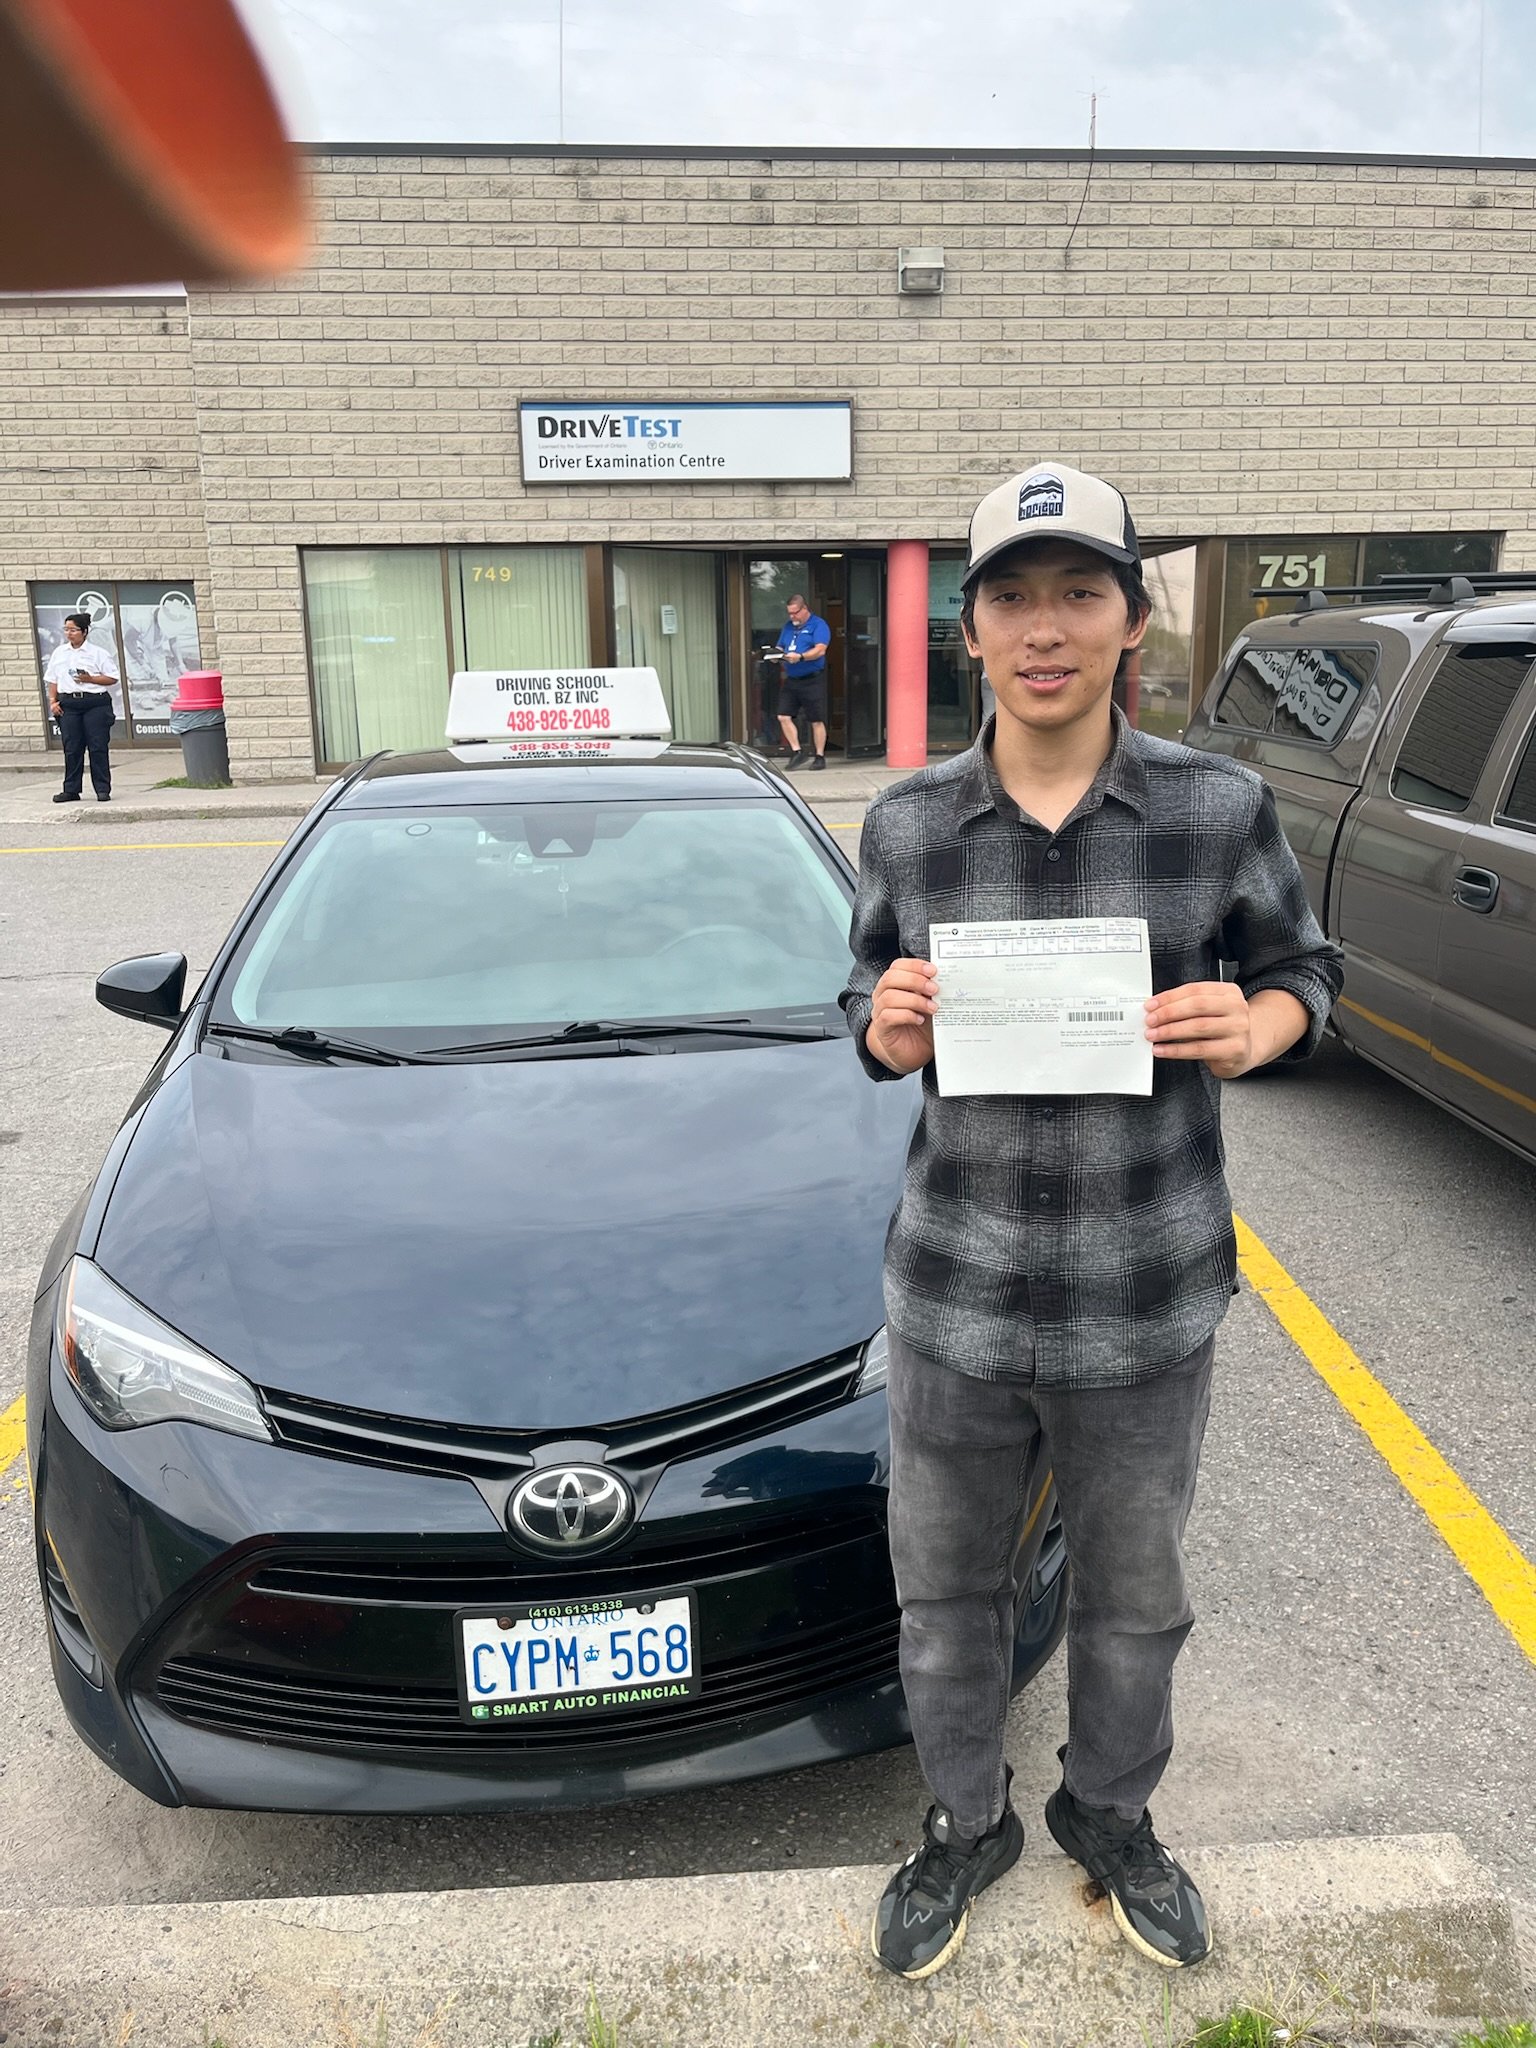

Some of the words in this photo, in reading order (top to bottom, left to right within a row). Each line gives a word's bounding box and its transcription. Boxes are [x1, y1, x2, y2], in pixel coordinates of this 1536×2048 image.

[658, 440, 683, 449] Ontario
[538, 454, 582, 469] Driver
[586, 453, 675, 468] Examination
[679, 453, 726, 467] Centre
[472, 566, 512, 582] 749
[1258, 554, 1327, 588] 751
[496, 676, 552, 692] DRIVING
[556, 675, 614, 690] SCHOOL.
[513, 691, 550, 706] COM.
[555, 691, 572, 705] BZ
[576, 689, 599, 704] INC
[507, 708, 610, 732] 438-926-2048
[528, 1606, 561, 1619] (416)
[565, 1600, 623, 1616] 613-8338
[531, 1609, 624, 1632] ONTARIO
[472, 1635, 580, 1694] CYPM
[610, 1623, 689, 1681] 568
[493, 1700, 550, 1717] SMART
[553, 1694, 598, 1711] AUTO
[602, 1683, 690, 1706] FINANCIAL
